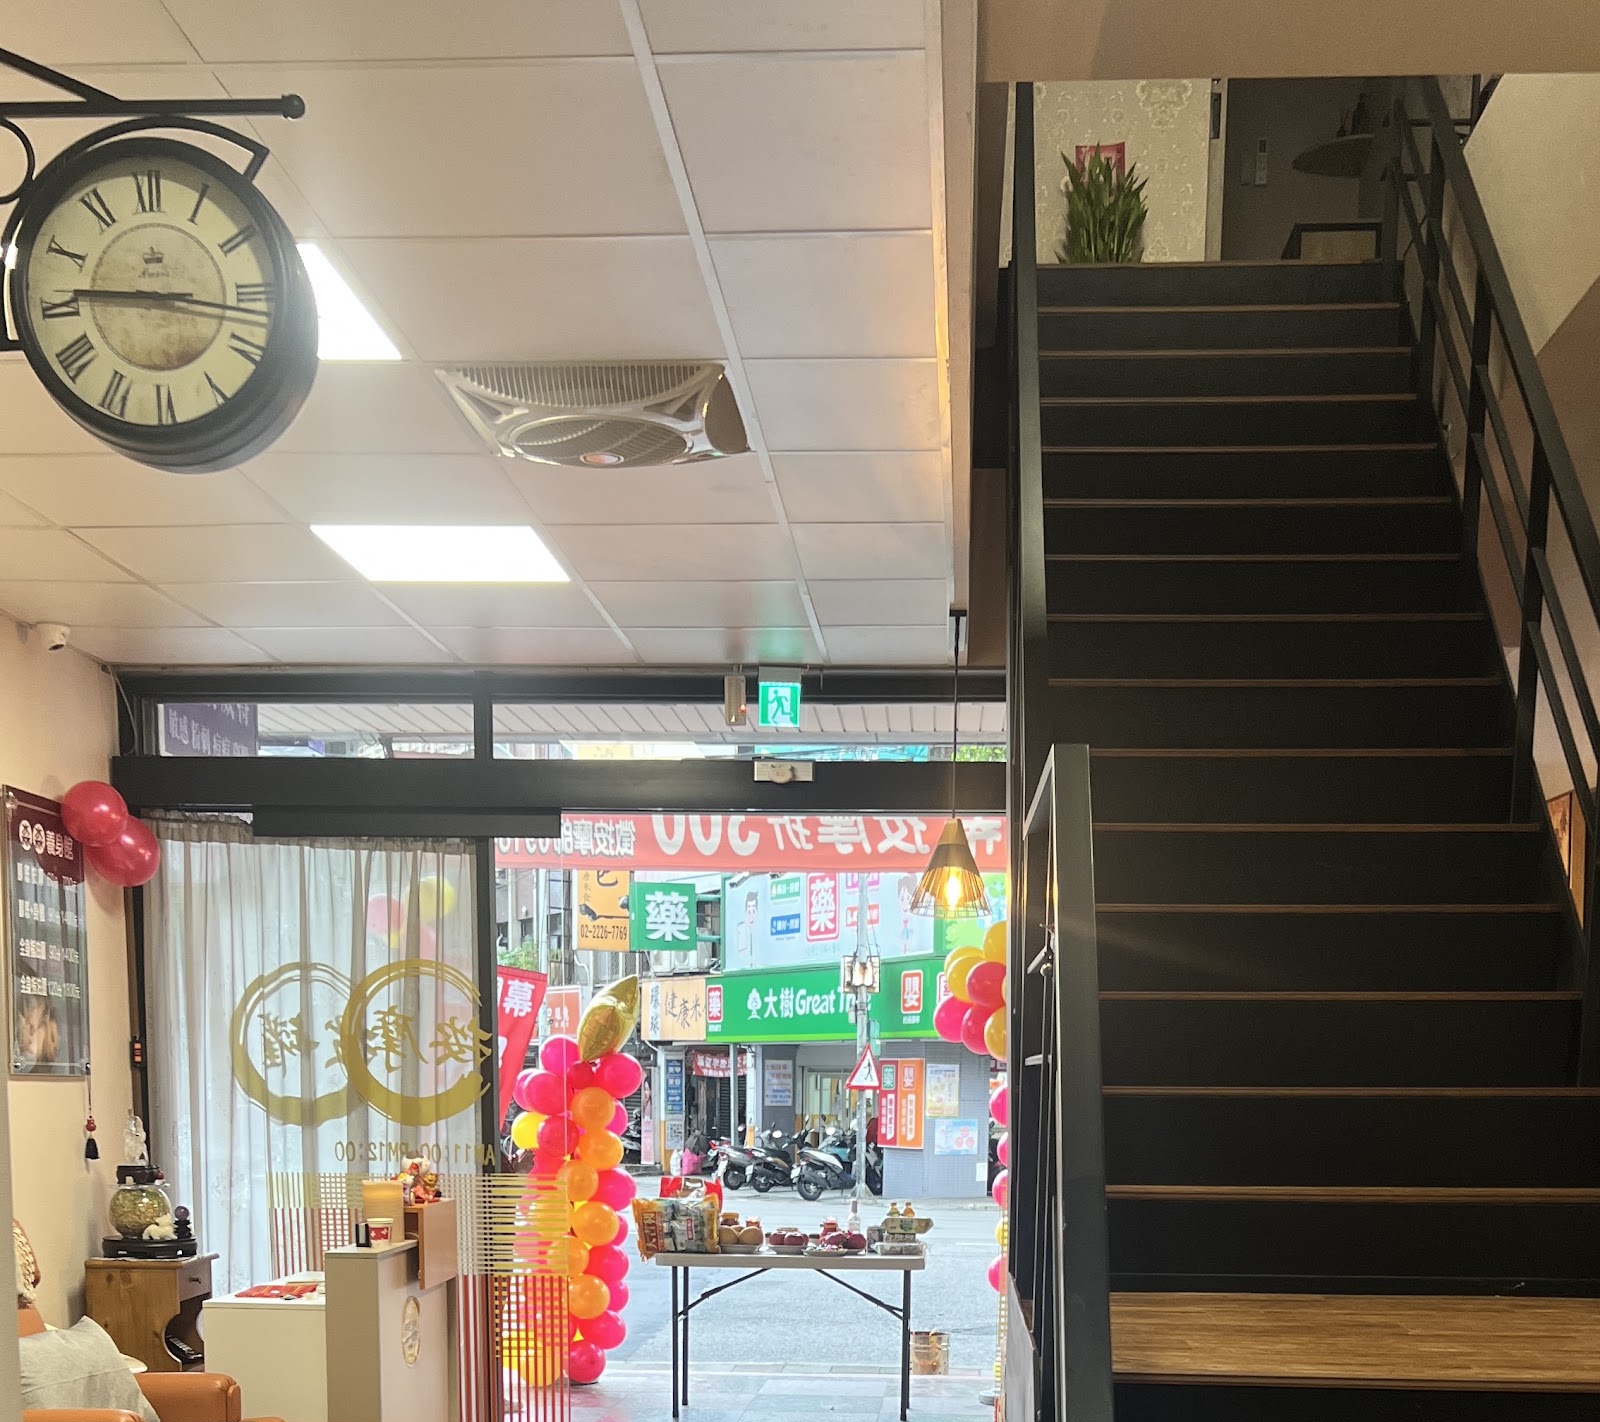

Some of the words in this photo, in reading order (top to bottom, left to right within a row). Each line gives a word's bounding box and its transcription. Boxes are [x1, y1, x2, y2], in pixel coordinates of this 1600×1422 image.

[80, 188, 117, 234] XI
[132, 170, 165, 214] XII
[46, 234, 88, 272] X
[645, 891, 690, 942] 藥
[811, 877, 836, 932] 藥
[580, 924, 628, 941] 02-2226-7769
[497, 976, 535, 1018] 幕
[665, 989, 706, 1030] 健康米
[764, 988, 794, 1019] 大樹
[795, 988, 836, 1016] Great
